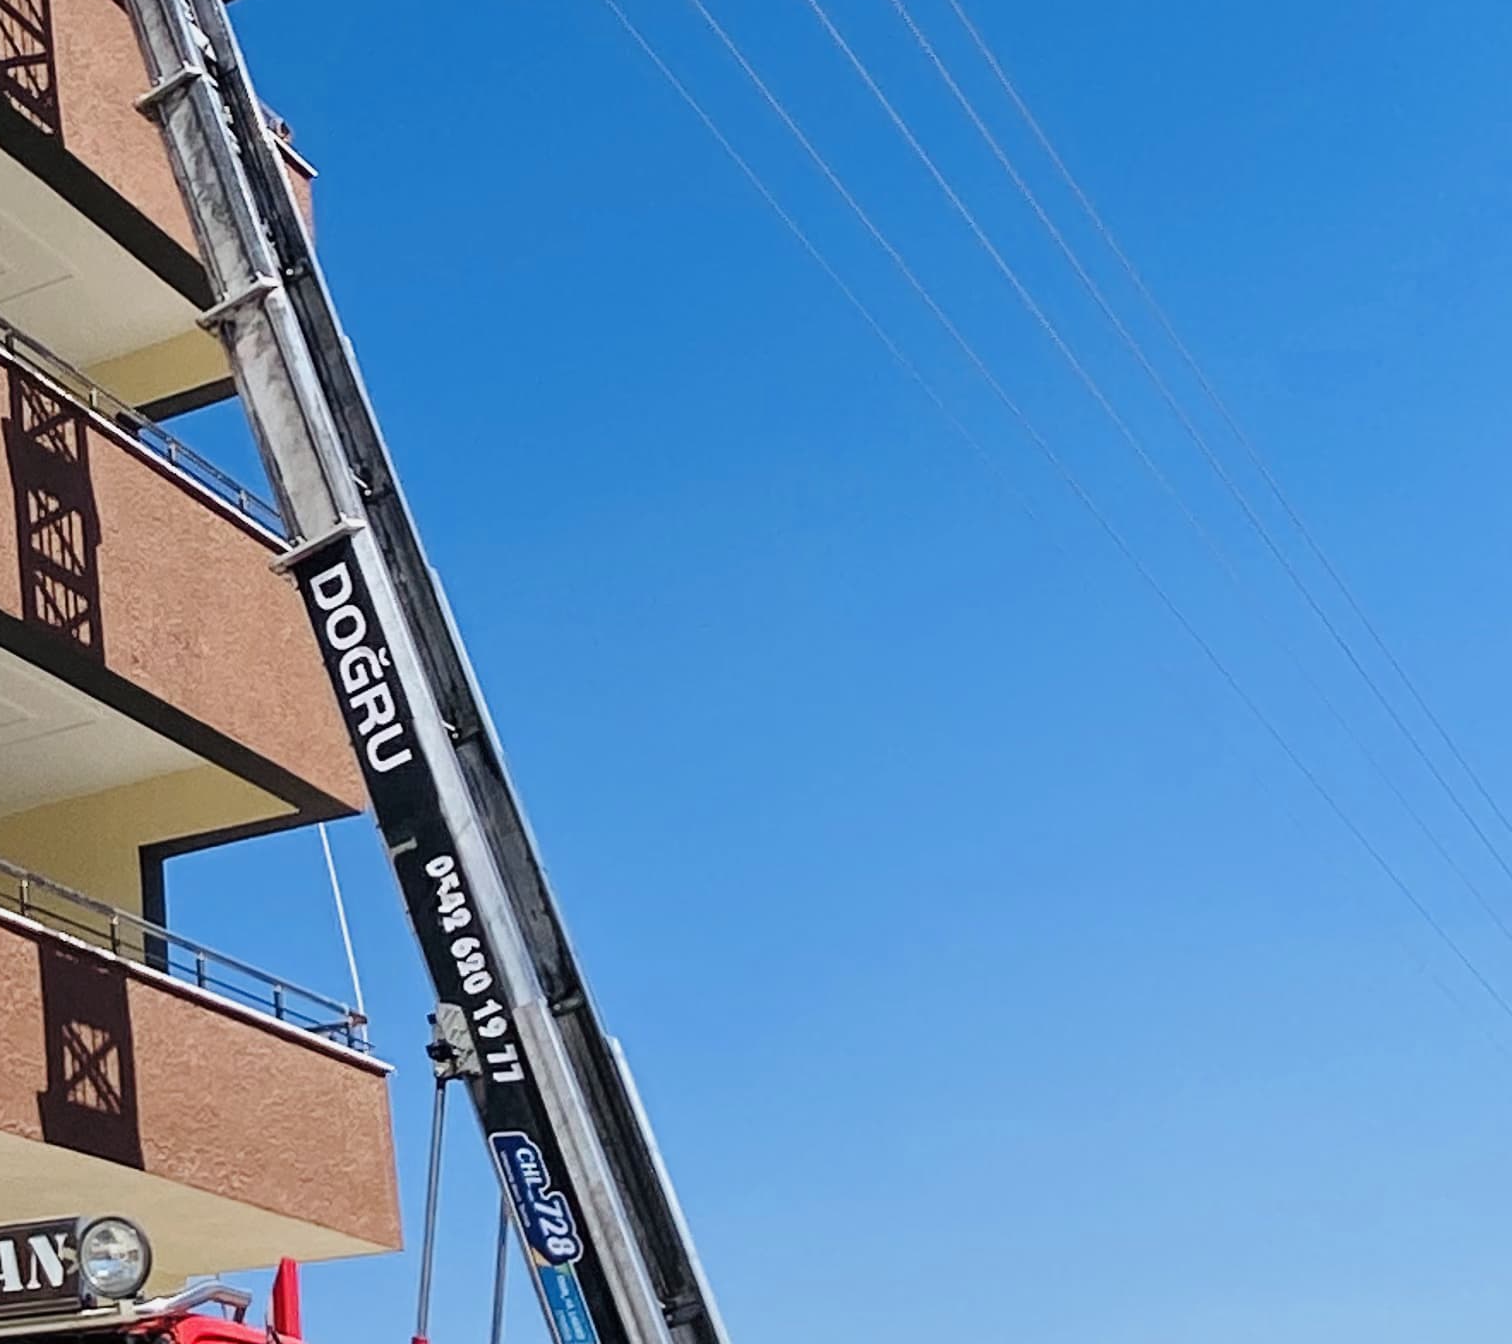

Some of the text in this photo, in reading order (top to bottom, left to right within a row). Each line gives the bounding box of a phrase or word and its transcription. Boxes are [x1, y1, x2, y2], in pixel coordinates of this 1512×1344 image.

[309, 561, 413, 774] DOĞRU
[449, 936, 492, 996] 620
[472, 998, 508, 1037] 19
[488, 1042, 527, 1085] 77
